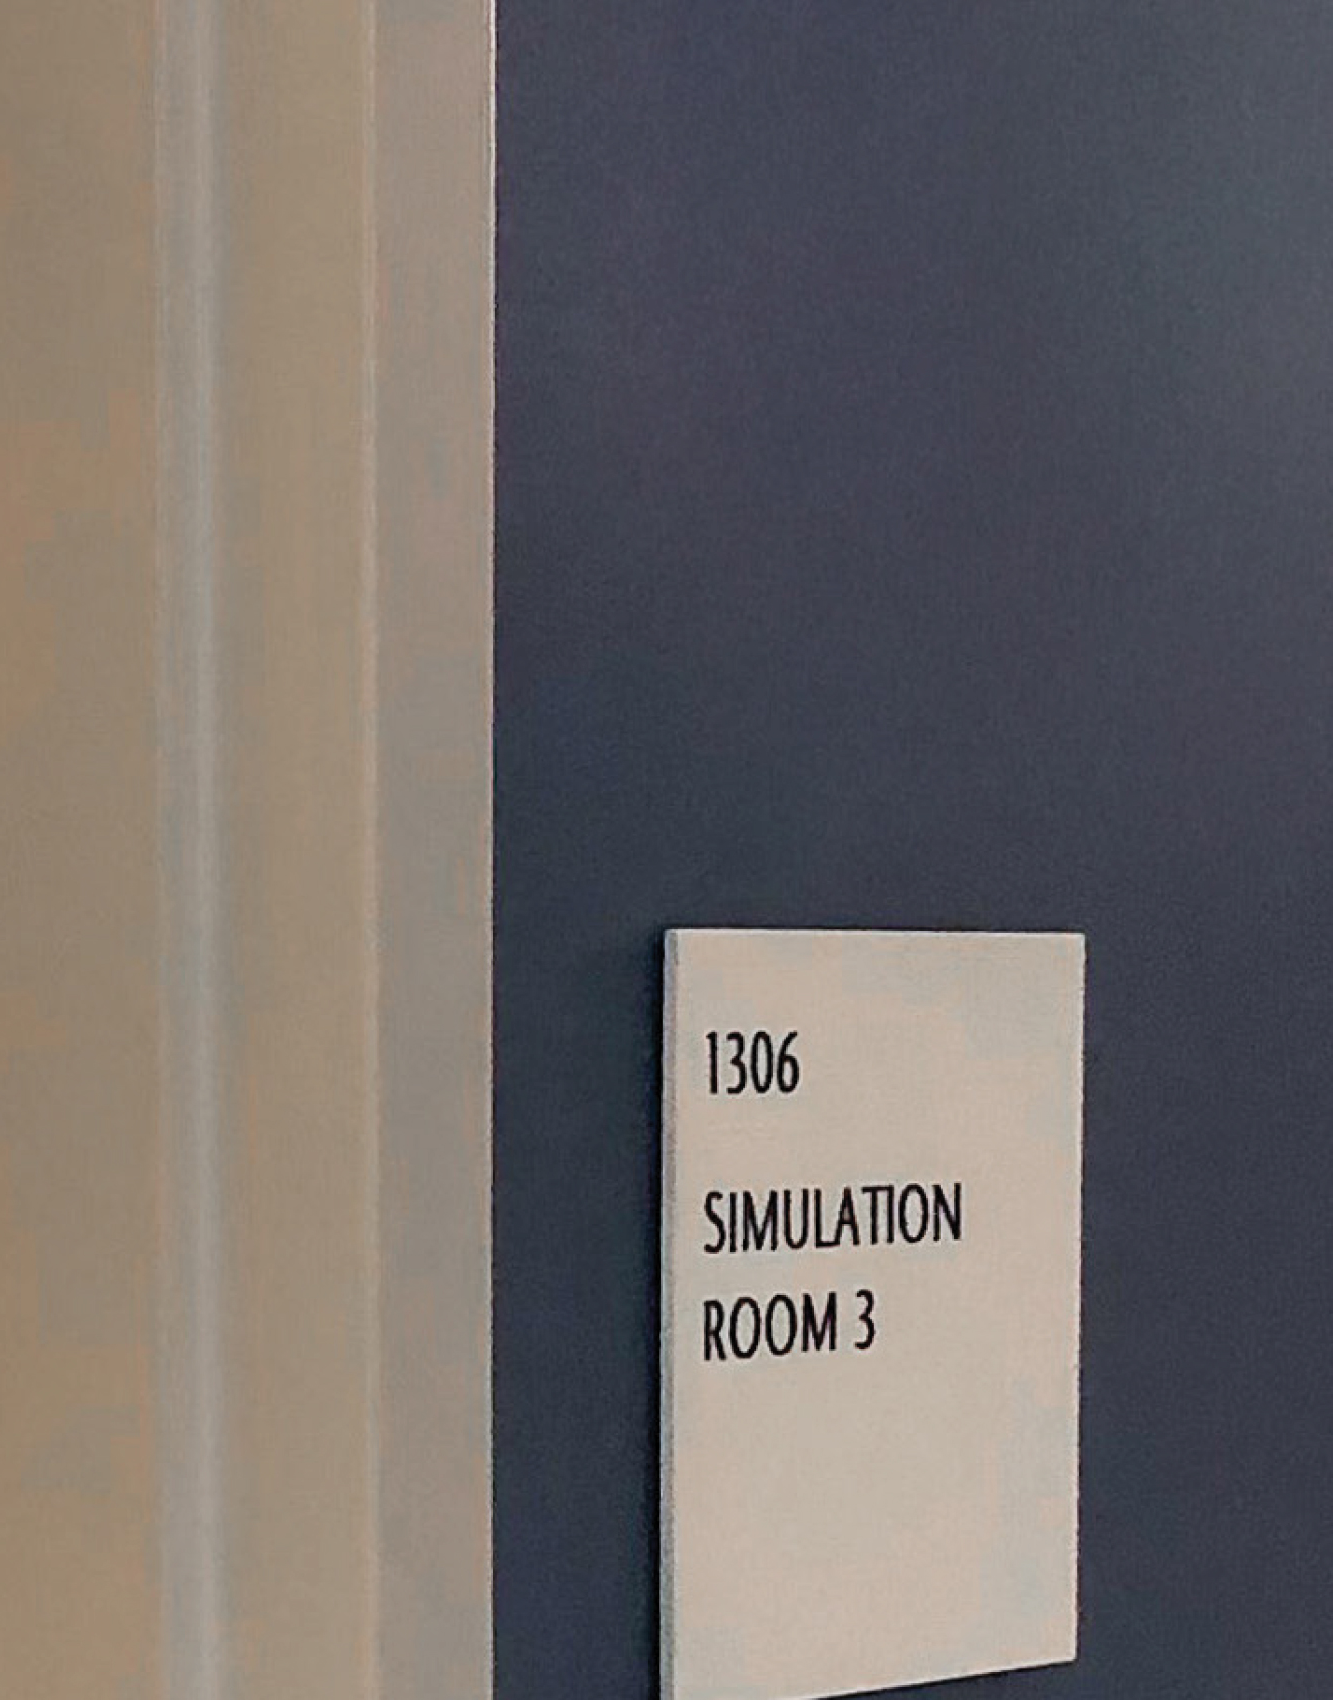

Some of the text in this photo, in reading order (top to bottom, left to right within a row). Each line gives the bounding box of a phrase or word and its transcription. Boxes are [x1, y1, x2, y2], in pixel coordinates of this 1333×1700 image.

[705, 1031, 800, 1095] 1306
[703, 1182, 963, 1255] SIMULATION
[703, 1288, 877, 1361] ROOM 3
